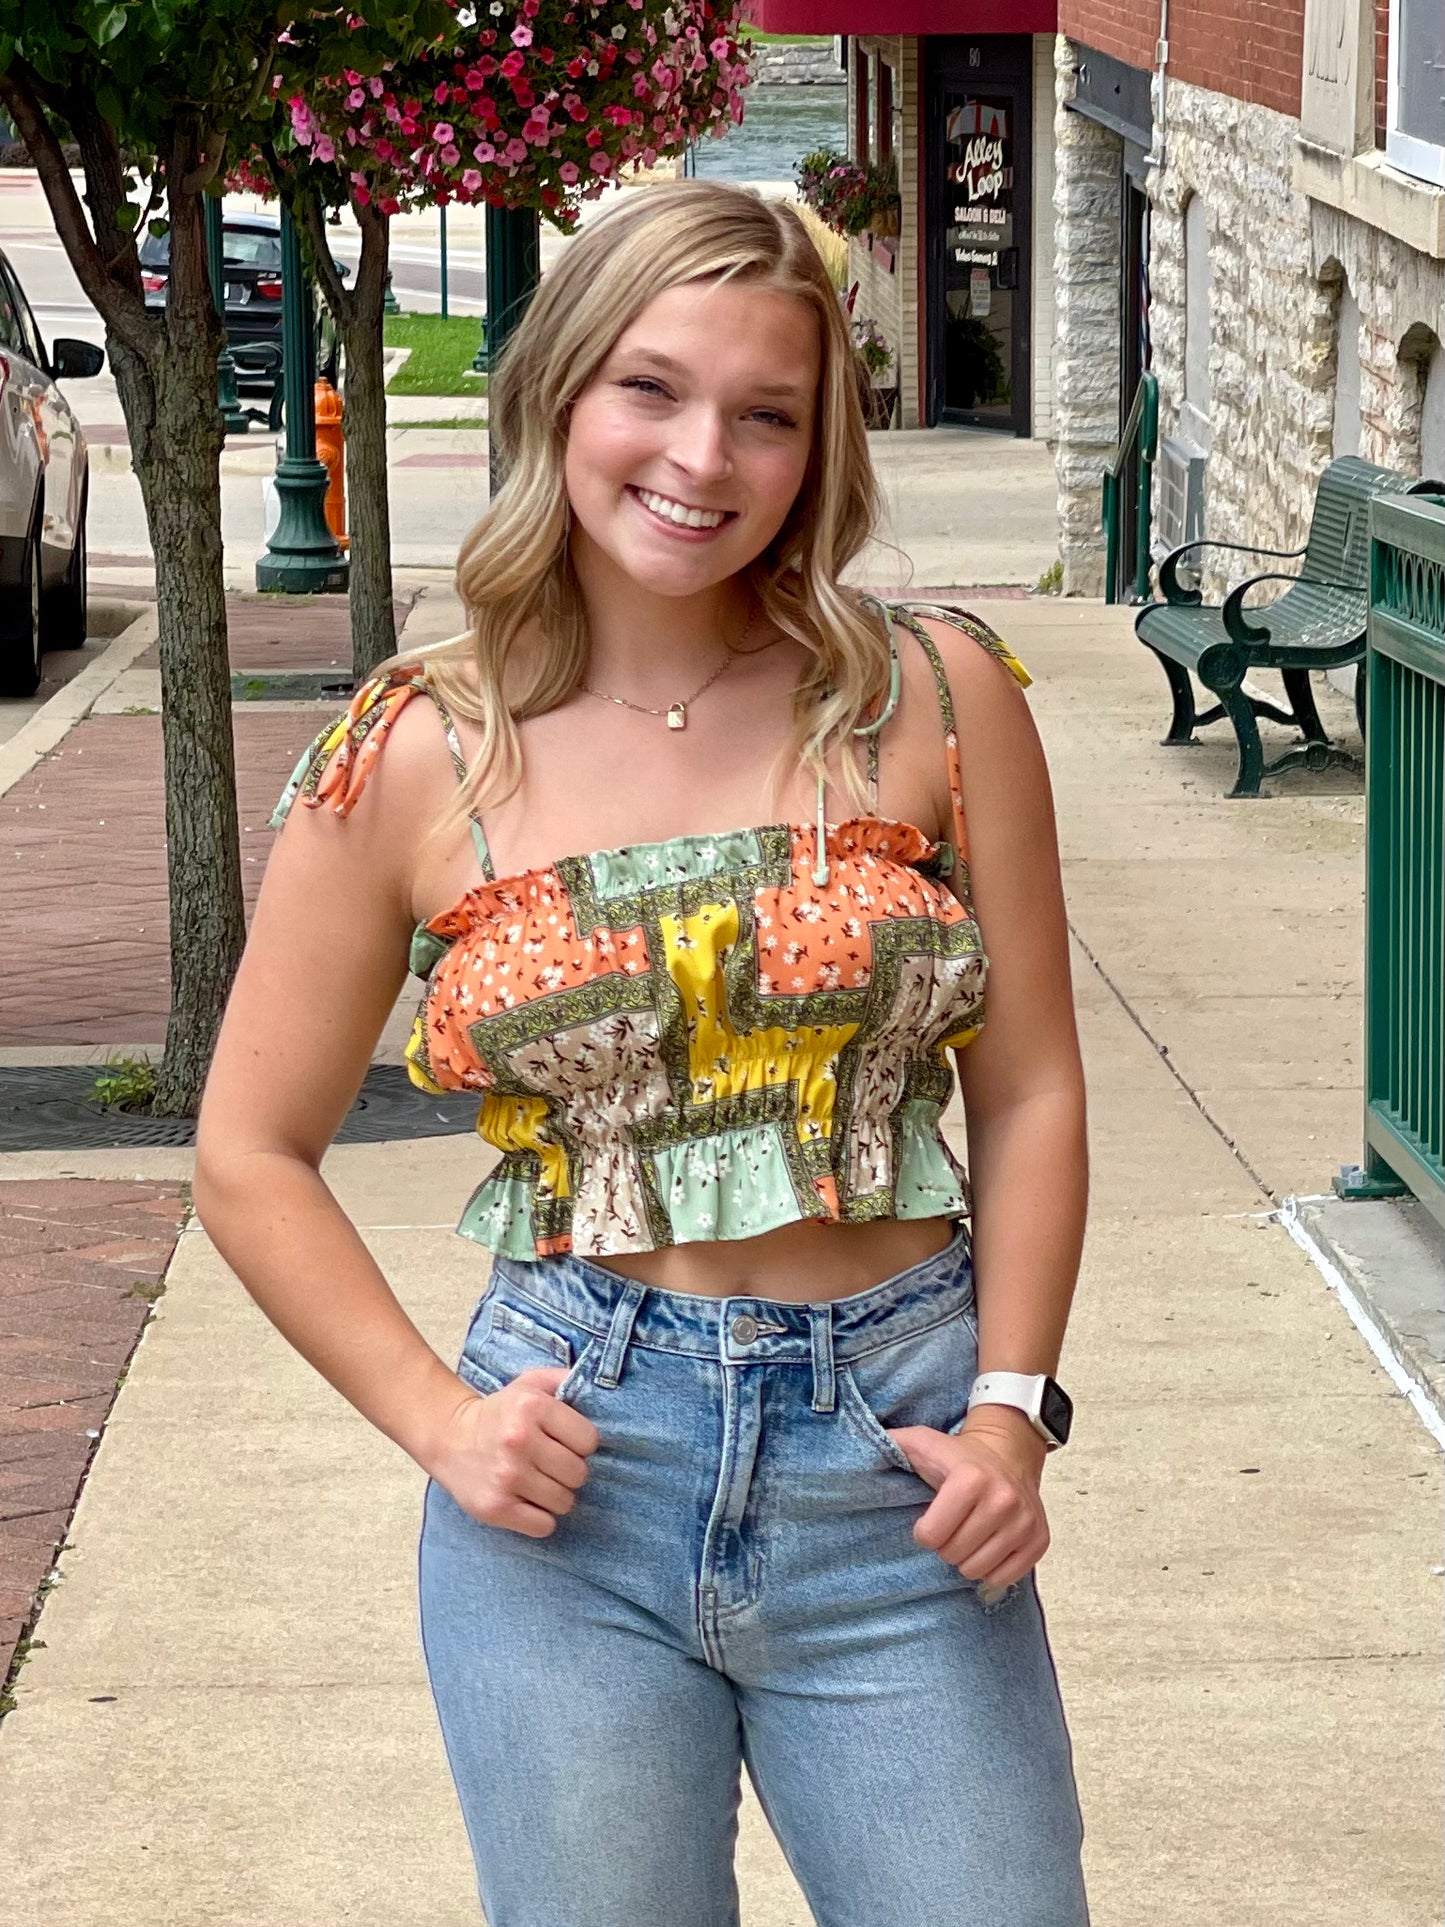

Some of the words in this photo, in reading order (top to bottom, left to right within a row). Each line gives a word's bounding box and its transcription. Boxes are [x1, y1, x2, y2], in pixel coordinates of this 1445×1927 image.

[969, 47, 981, 67] 80
[956, 135, 1003, 182] Alley
[967, 169, 1004, 202] Loop
[954, 206, 982, 222] SALOON
[989, 208, 1006, 224] DELI
